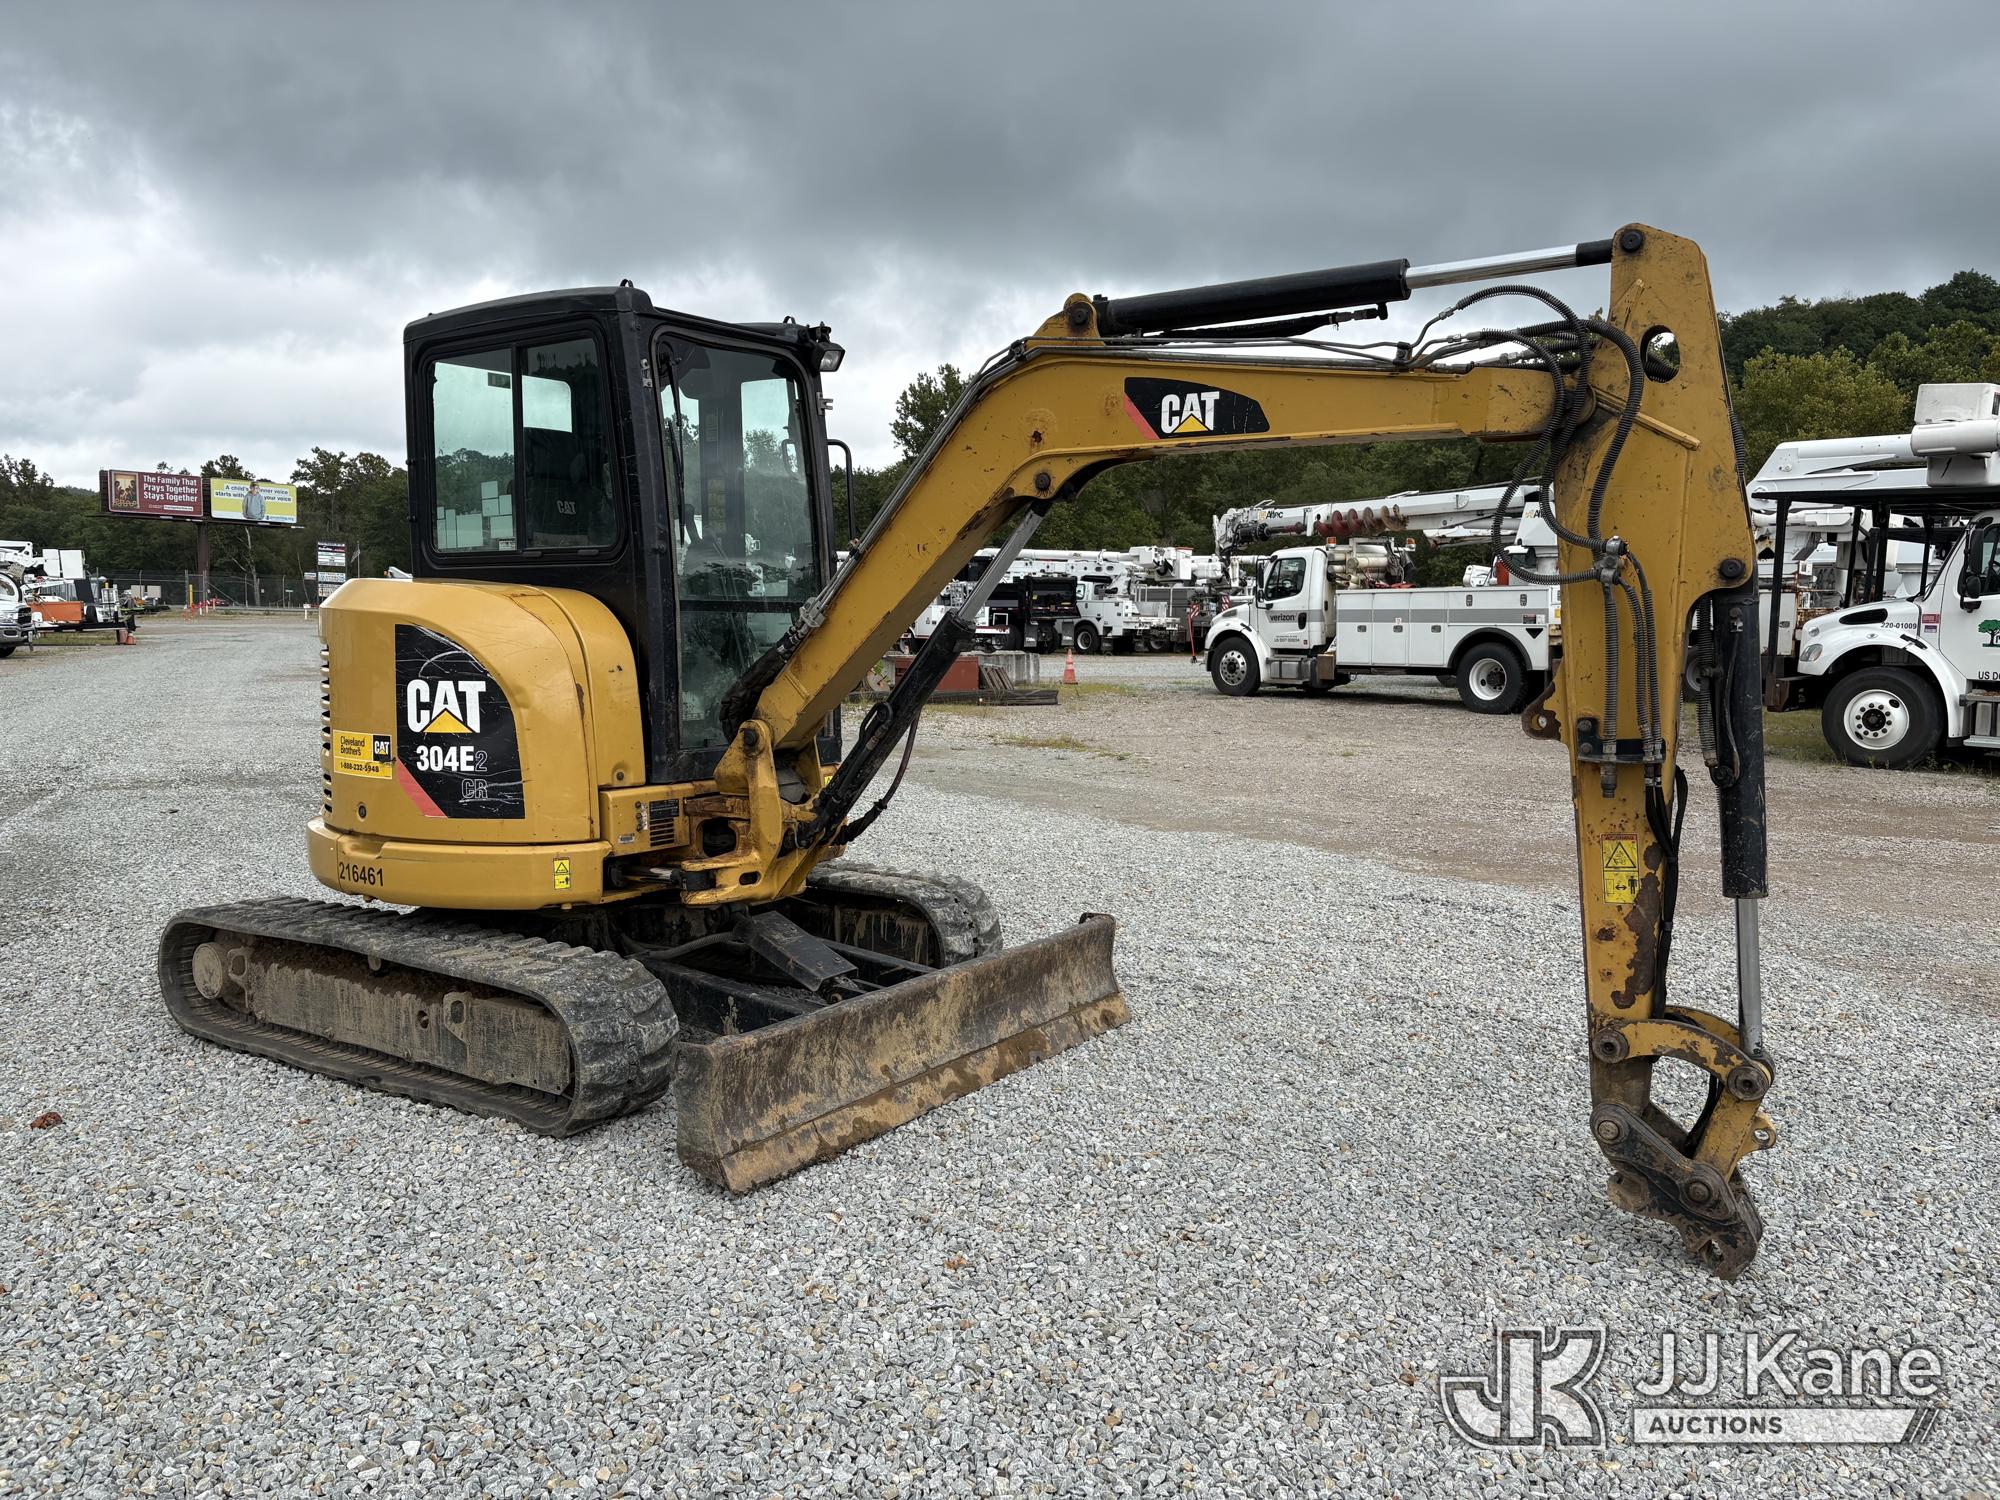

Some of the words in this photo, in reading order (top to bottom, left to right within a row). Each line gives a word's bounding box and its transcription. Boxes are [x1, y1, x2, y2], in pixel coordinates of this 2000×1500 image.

[1161, 391, 1220, 434] CAT
[143, 475, 156, 483] The
[157, 476, 180, 486] Family
[182, 478, 197, 486] That
[143, 483, 165, 493] Prays
[165, 484, 198, 494] Together
[143, 491, 165, 501] Stays
[165, 492, 198, 503] Together
[556, 500, 577, 515] CAT
[1270, 613, 1295, 621] verizon
[1880, 622, 1917, 630] 220-01009
[1978, 671, 1990, 680] US
[407, 679, 487, 734] CAT
[341, 736, 365, 747] Cleveland
[374, 740, 390, 755] CAT
[461, 778, 488, 799] CR
[339, 861, 384, 887] 216461
